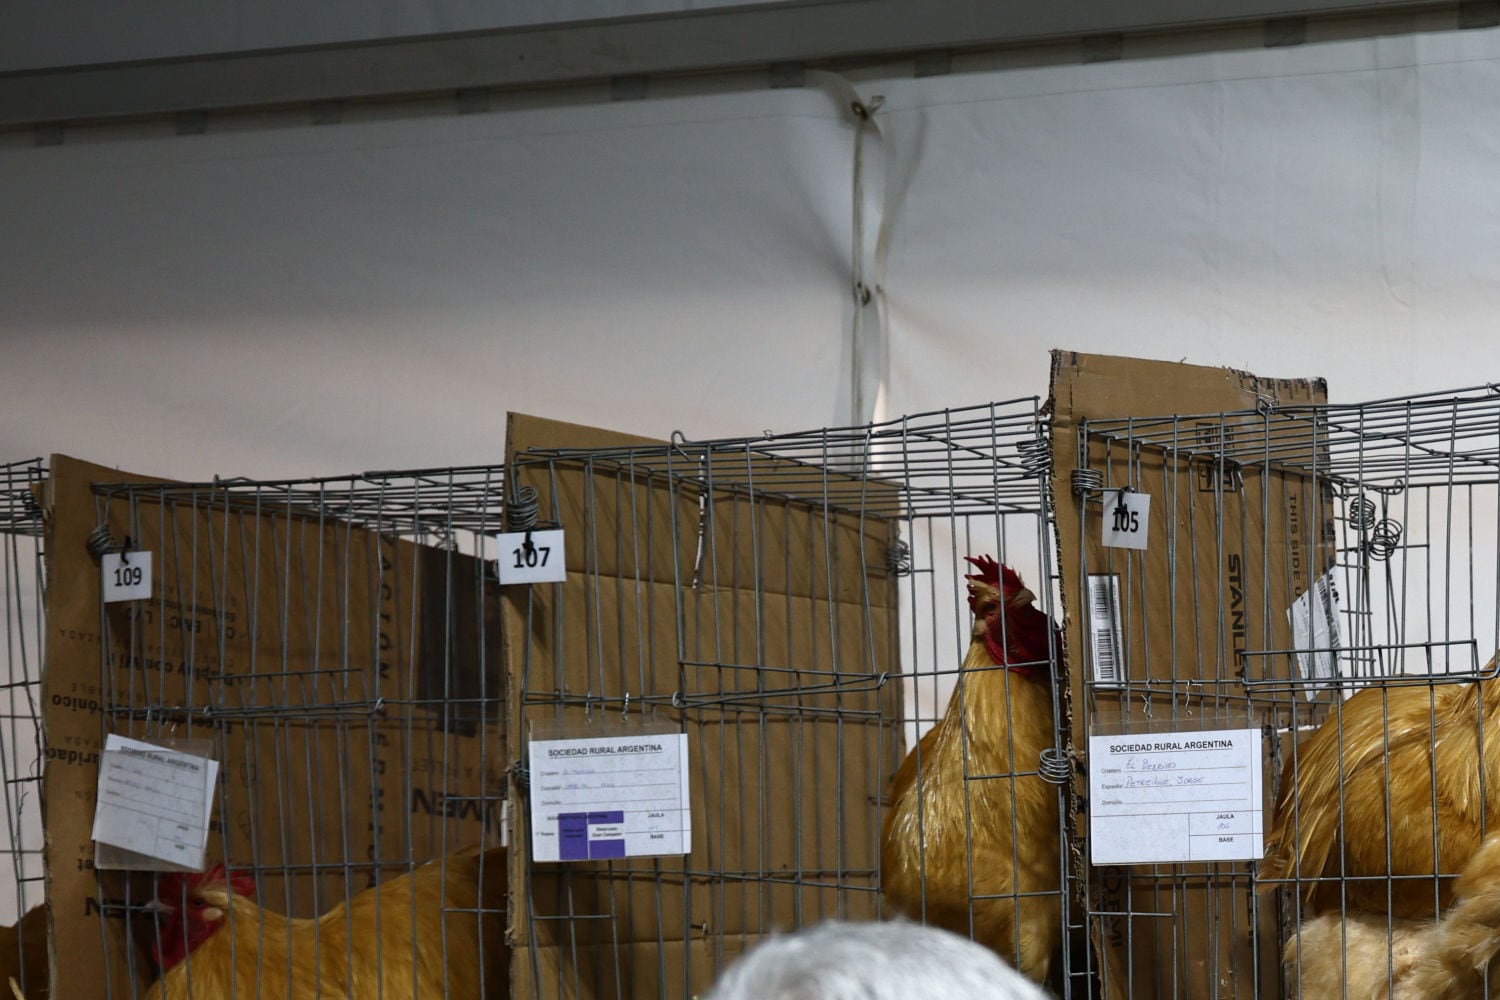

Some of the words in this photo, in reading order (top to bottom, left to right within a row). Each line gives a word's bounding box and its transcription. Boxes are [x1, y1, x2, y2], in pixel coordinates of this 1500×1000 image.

[1112, 511, 1139, 532] 105
[513, 547, 550, 568] 107
[114, 567, 142, 587] 109
[1228, 553, 1245, 678] STANLEY
[548, 749, 587, 757] SOCIEDAD
[589, 746, 615, 754] RURAL
[617, 744, 662, 753] ARGENTINA
[1110, 744, 1152, 753] SOCIEDAD
[1154, 742, 1182, 751] RURAL
[1184, 740, 1233, 749] ARGENTINA
